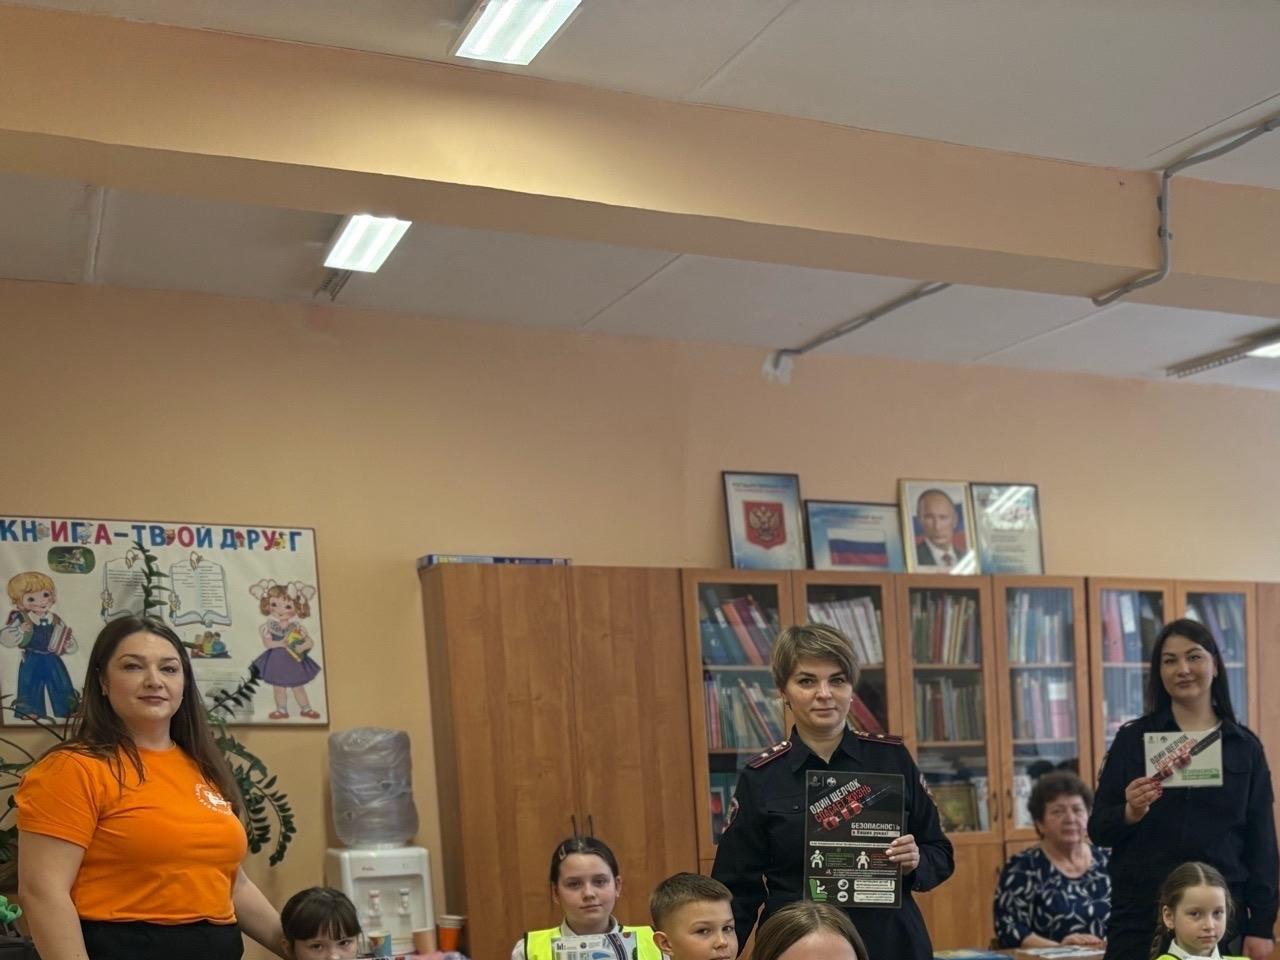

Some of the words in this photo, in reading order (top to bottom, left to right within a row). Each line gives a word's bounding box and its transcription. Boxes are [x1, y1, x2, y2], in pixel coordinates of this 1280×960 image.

[220, 528, 303, 552] ДРУГ
[809, 796, 832, 815] ОДИН
[829, 778, 861, 803] ЩЕЛЧОК
[814, 799, 846, 823] СПАСАЕТ
[845, 783, 872, 804] ЖИЗНЬ
[851, 822, 900, 830] БЕЗОПАСНОСТЬ
